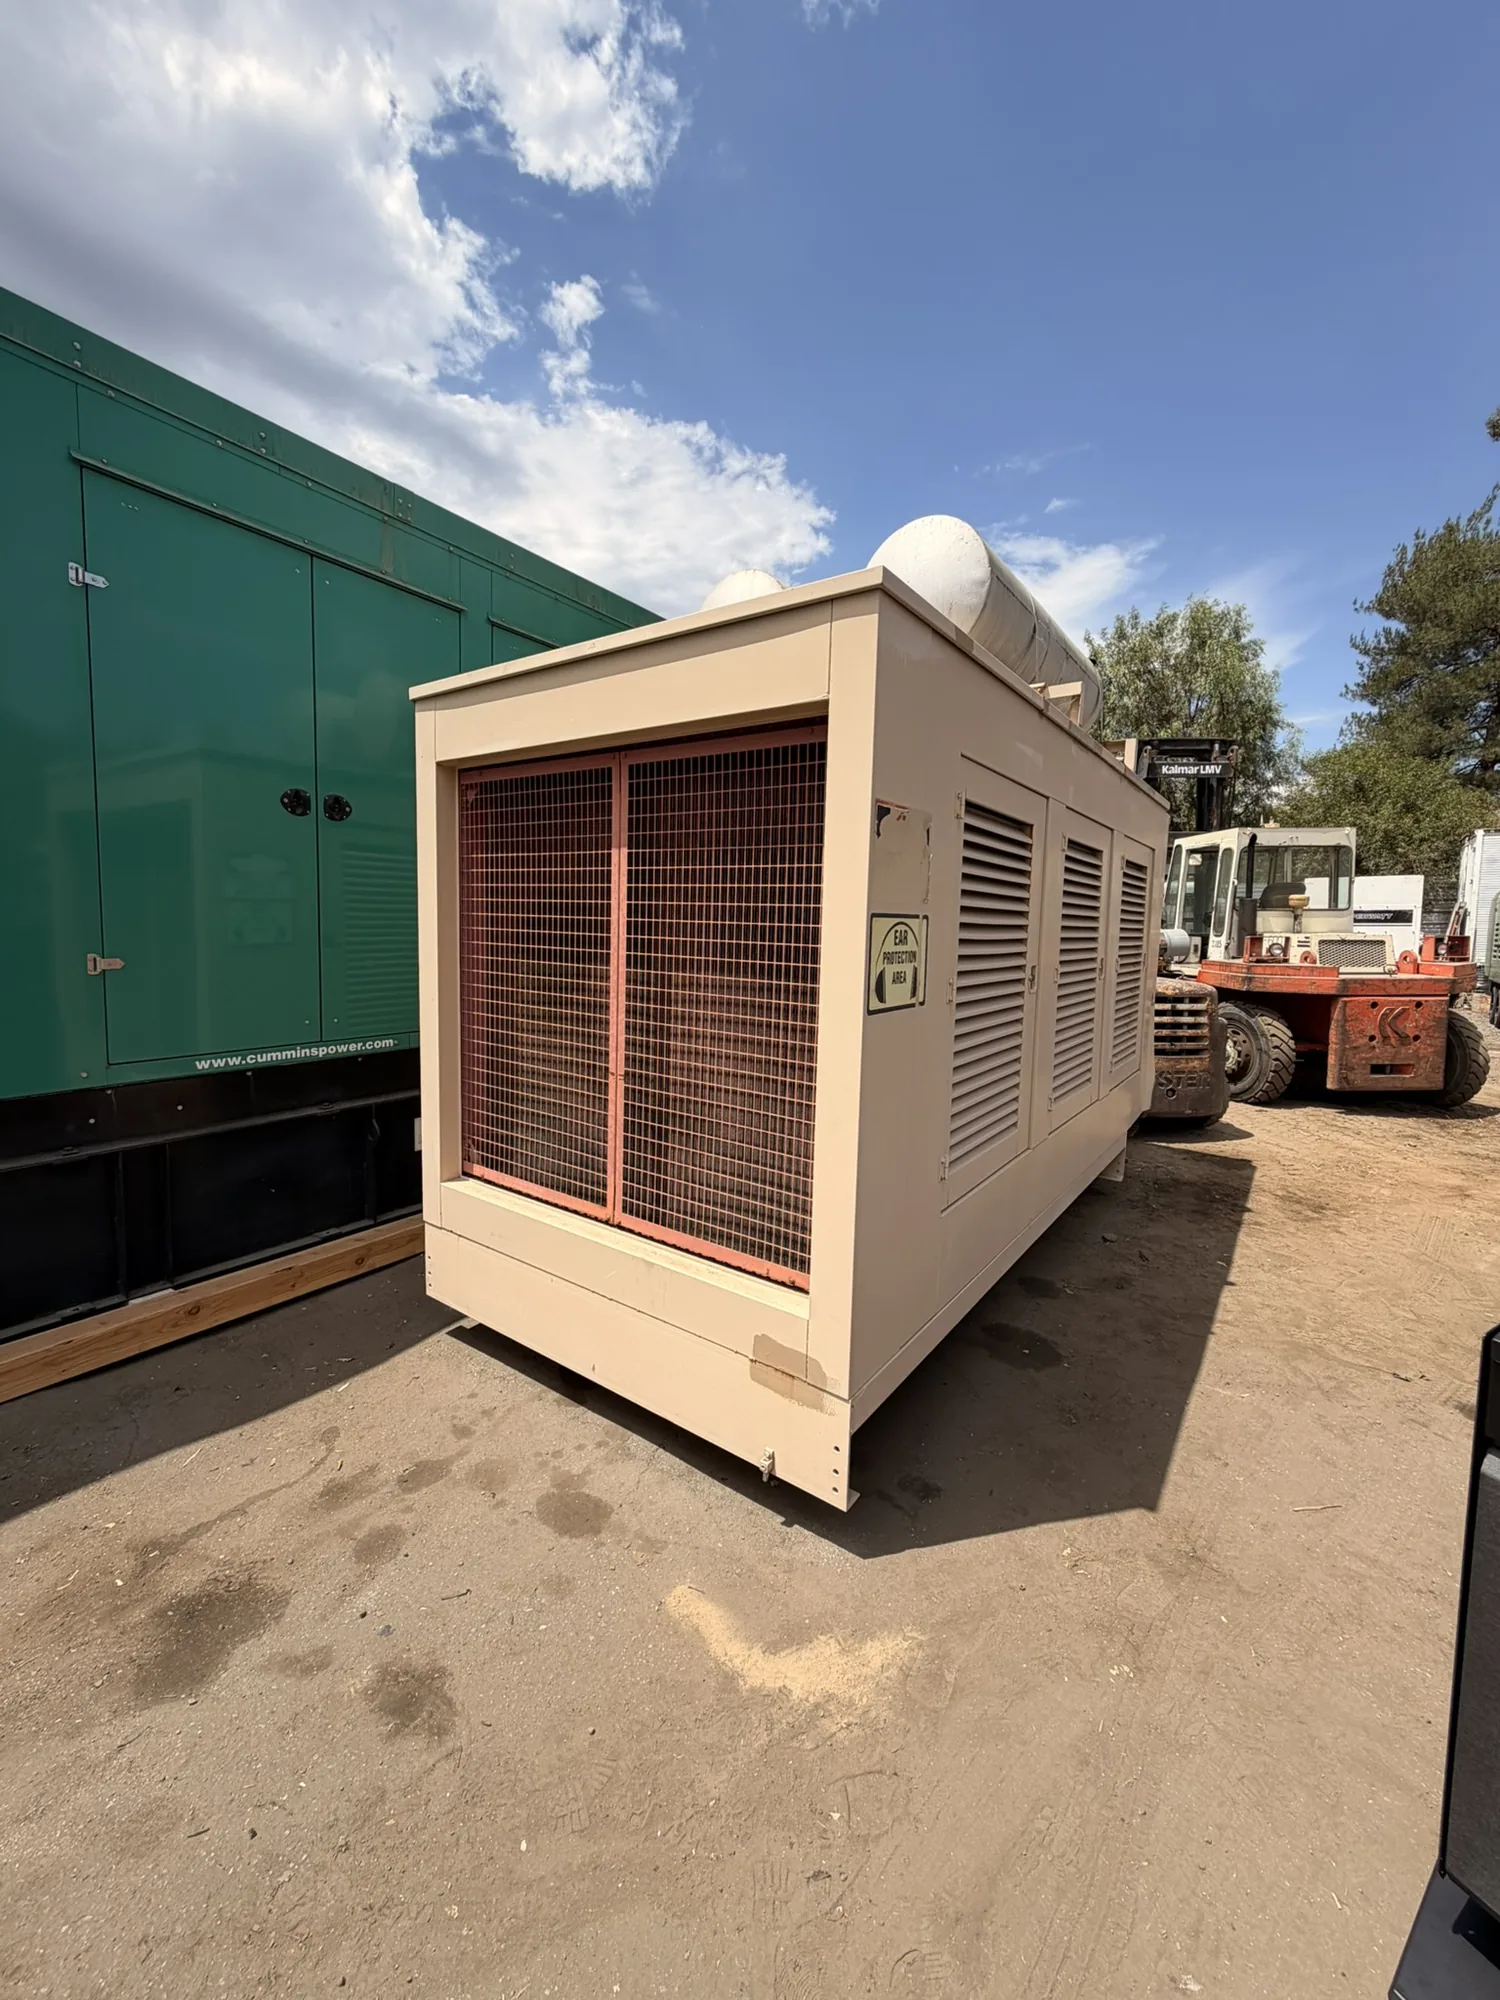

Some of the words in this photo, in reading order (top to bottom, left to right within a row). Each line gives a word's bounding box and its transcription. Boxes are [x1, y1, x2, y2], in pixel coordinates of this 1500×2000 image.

[1161, 764, 1199, 775] Kalmar
[1200, 764, 1222, 774] LMV
[894, 929, 908, 946] EAR
[882, 950, 917, 965] PROTECTION
[891, 970, 907, 985] AREA
[195, 1038, 394, 1070] www.cumminspower.com
